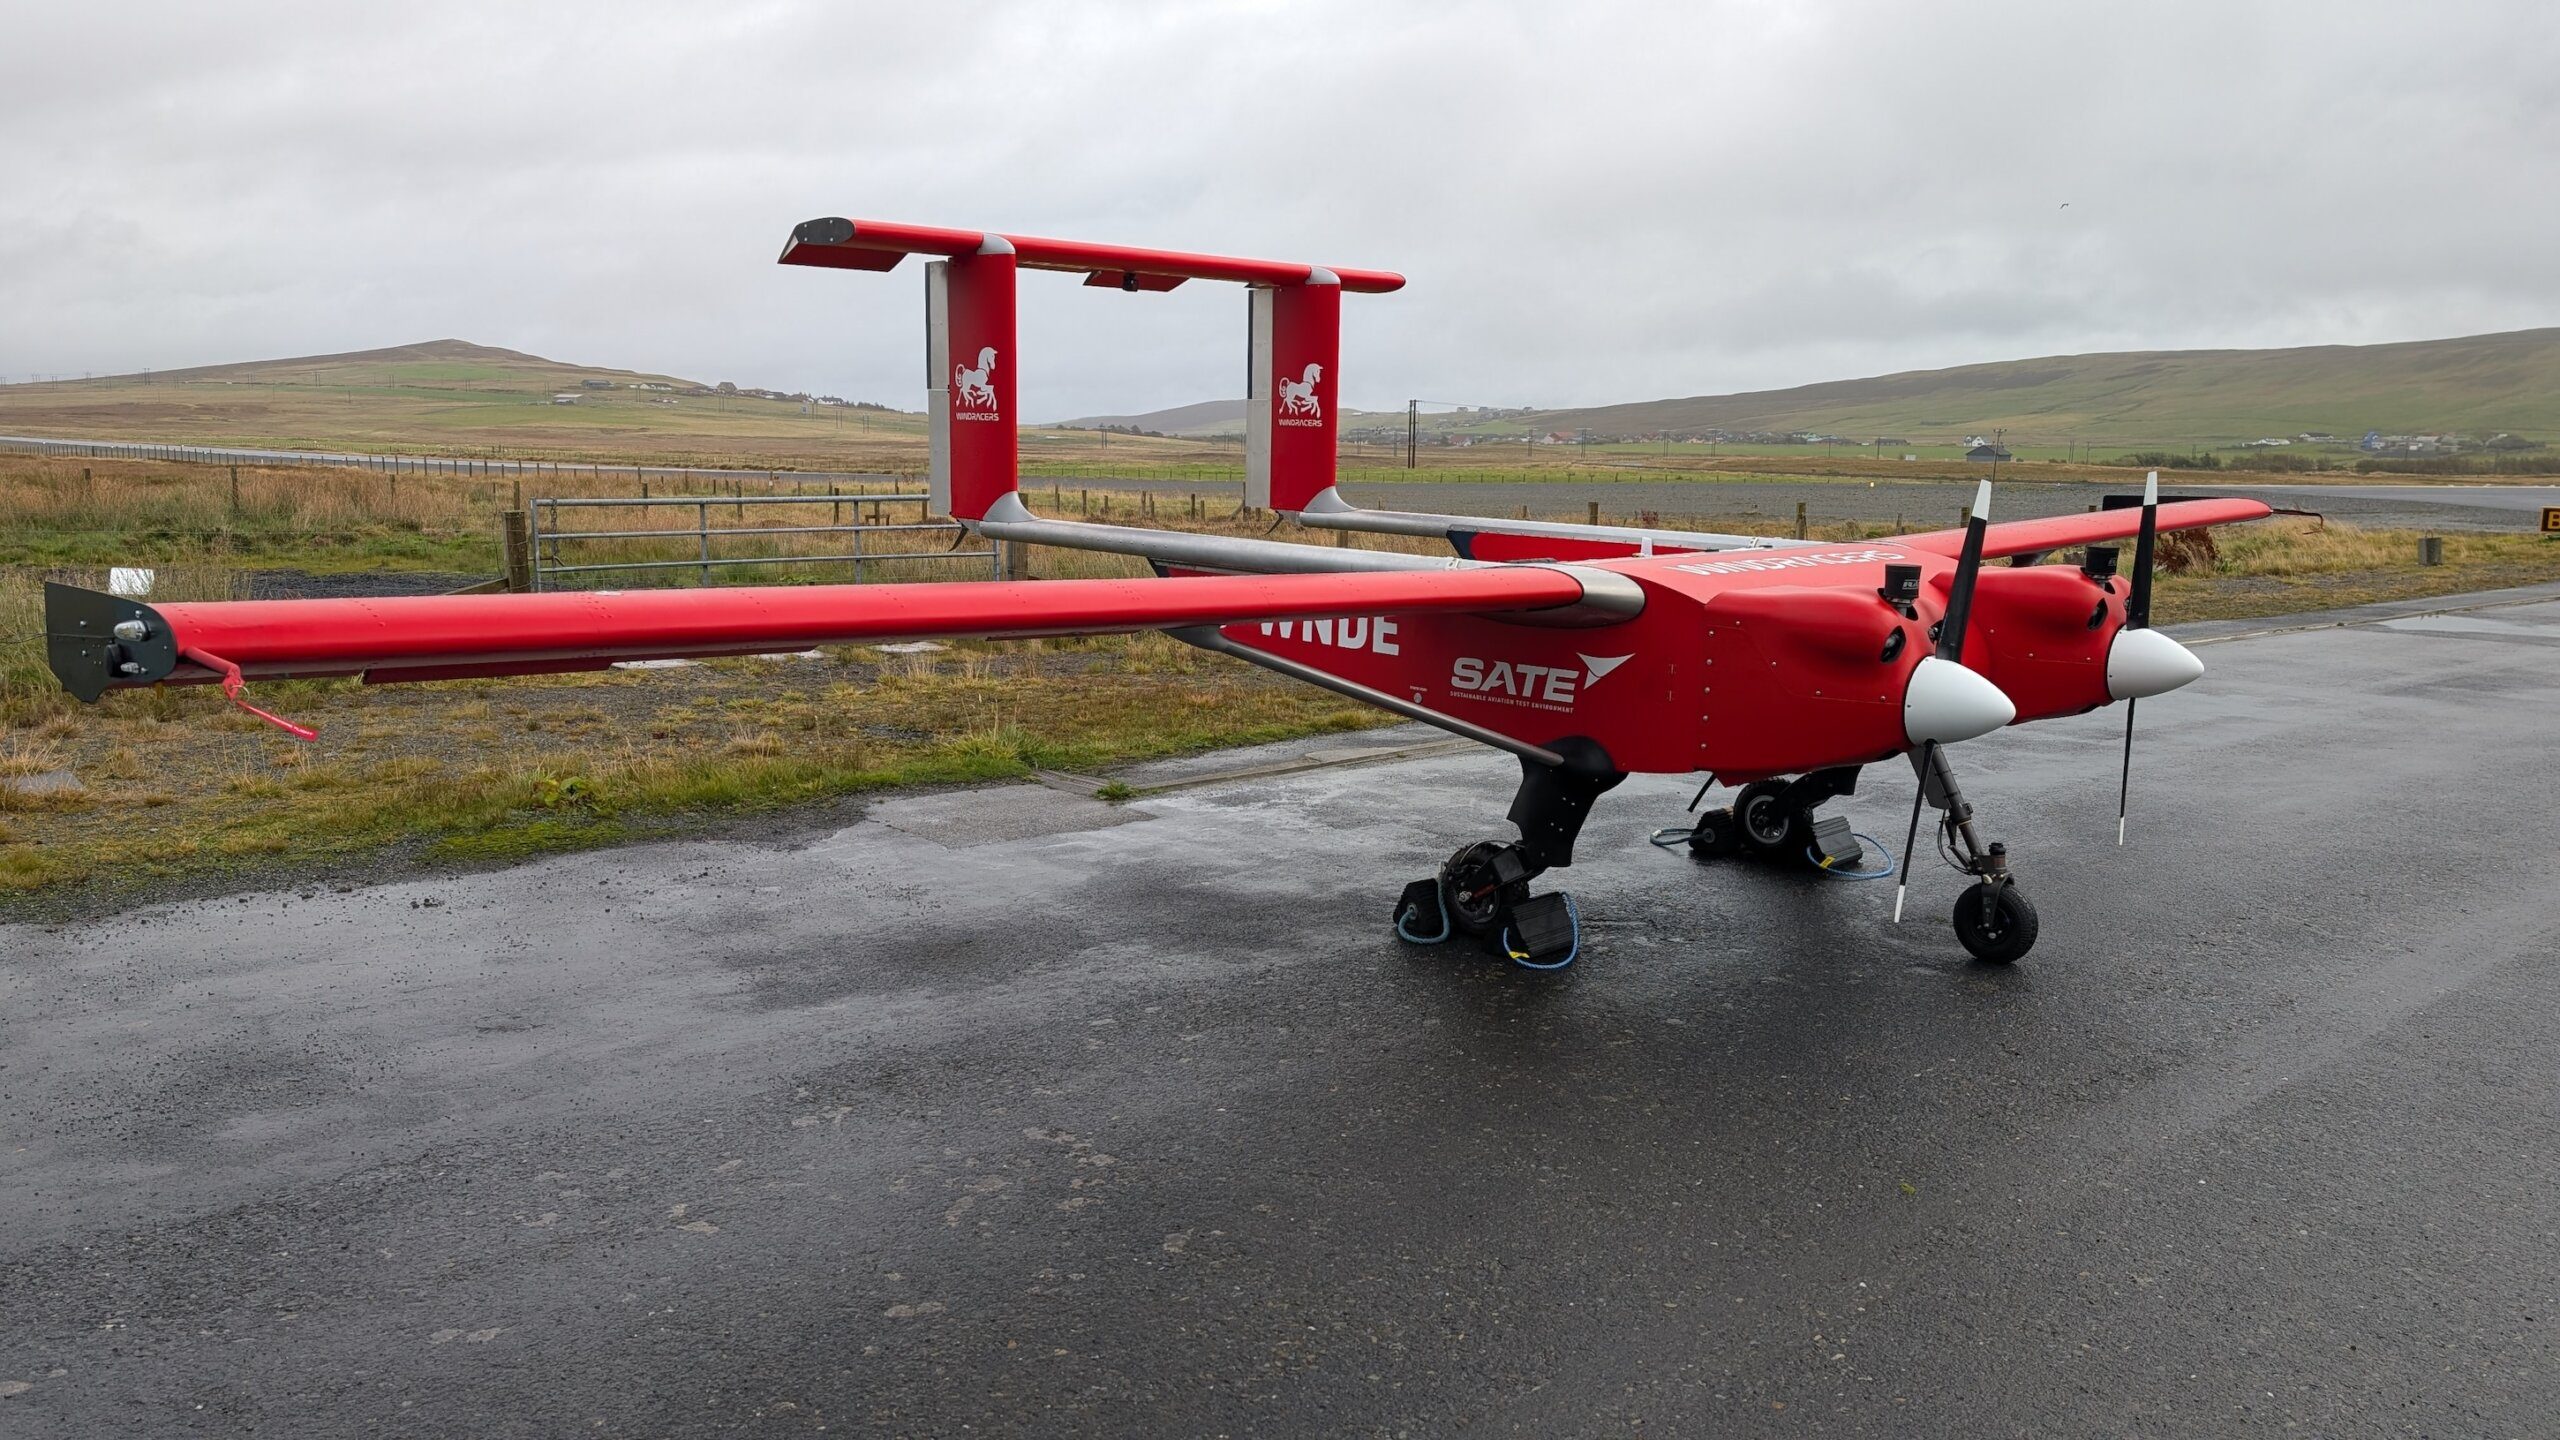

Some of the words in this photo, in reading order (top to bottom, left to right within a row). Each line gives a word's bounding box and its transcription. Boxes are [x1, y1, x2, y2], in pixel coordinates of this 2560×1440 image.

[955, 412, 999, 421] WINDRACERS
[1278, 418, 1322, 427] WINDRACERS
[1663, 550, 1906, 575] WINDRACERS
[1451, 657, 1579, 703] SATE
[1450, 691, 1487, 701] SUSTAINABLE
[1488, 696, 1514, 705] AVIATION
[1516, 700, 1530, 708] TEST
[1531, 703, 1574, 714] ENVIRONMENT
